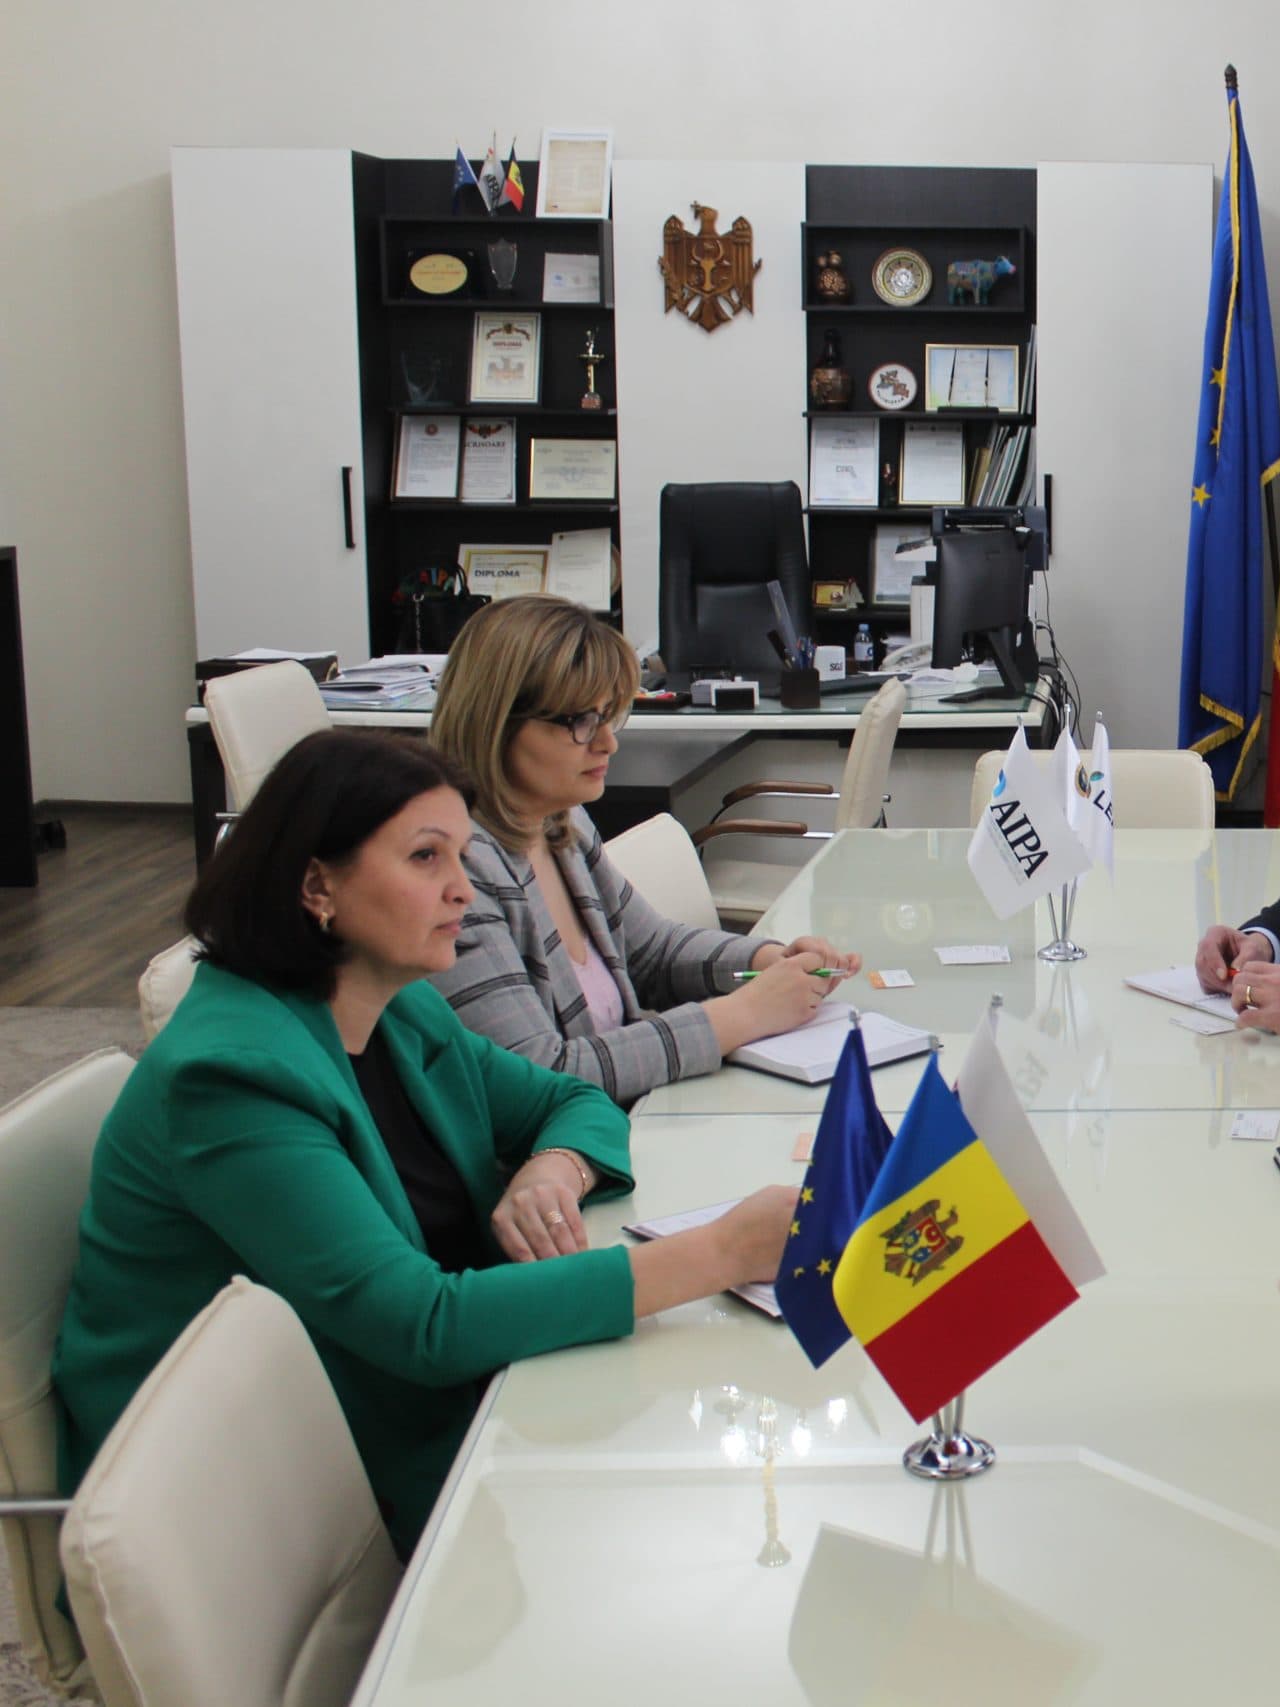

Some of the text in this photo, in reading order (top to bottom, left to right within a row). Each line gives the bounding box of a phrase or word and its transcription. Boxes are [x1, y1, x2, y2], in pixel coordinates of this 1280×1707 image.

[474, 569, 520, 577] DIPLOMA
[1093, 789, 1114, 827] LE
[990, 799, 1049, 879] AIPA
